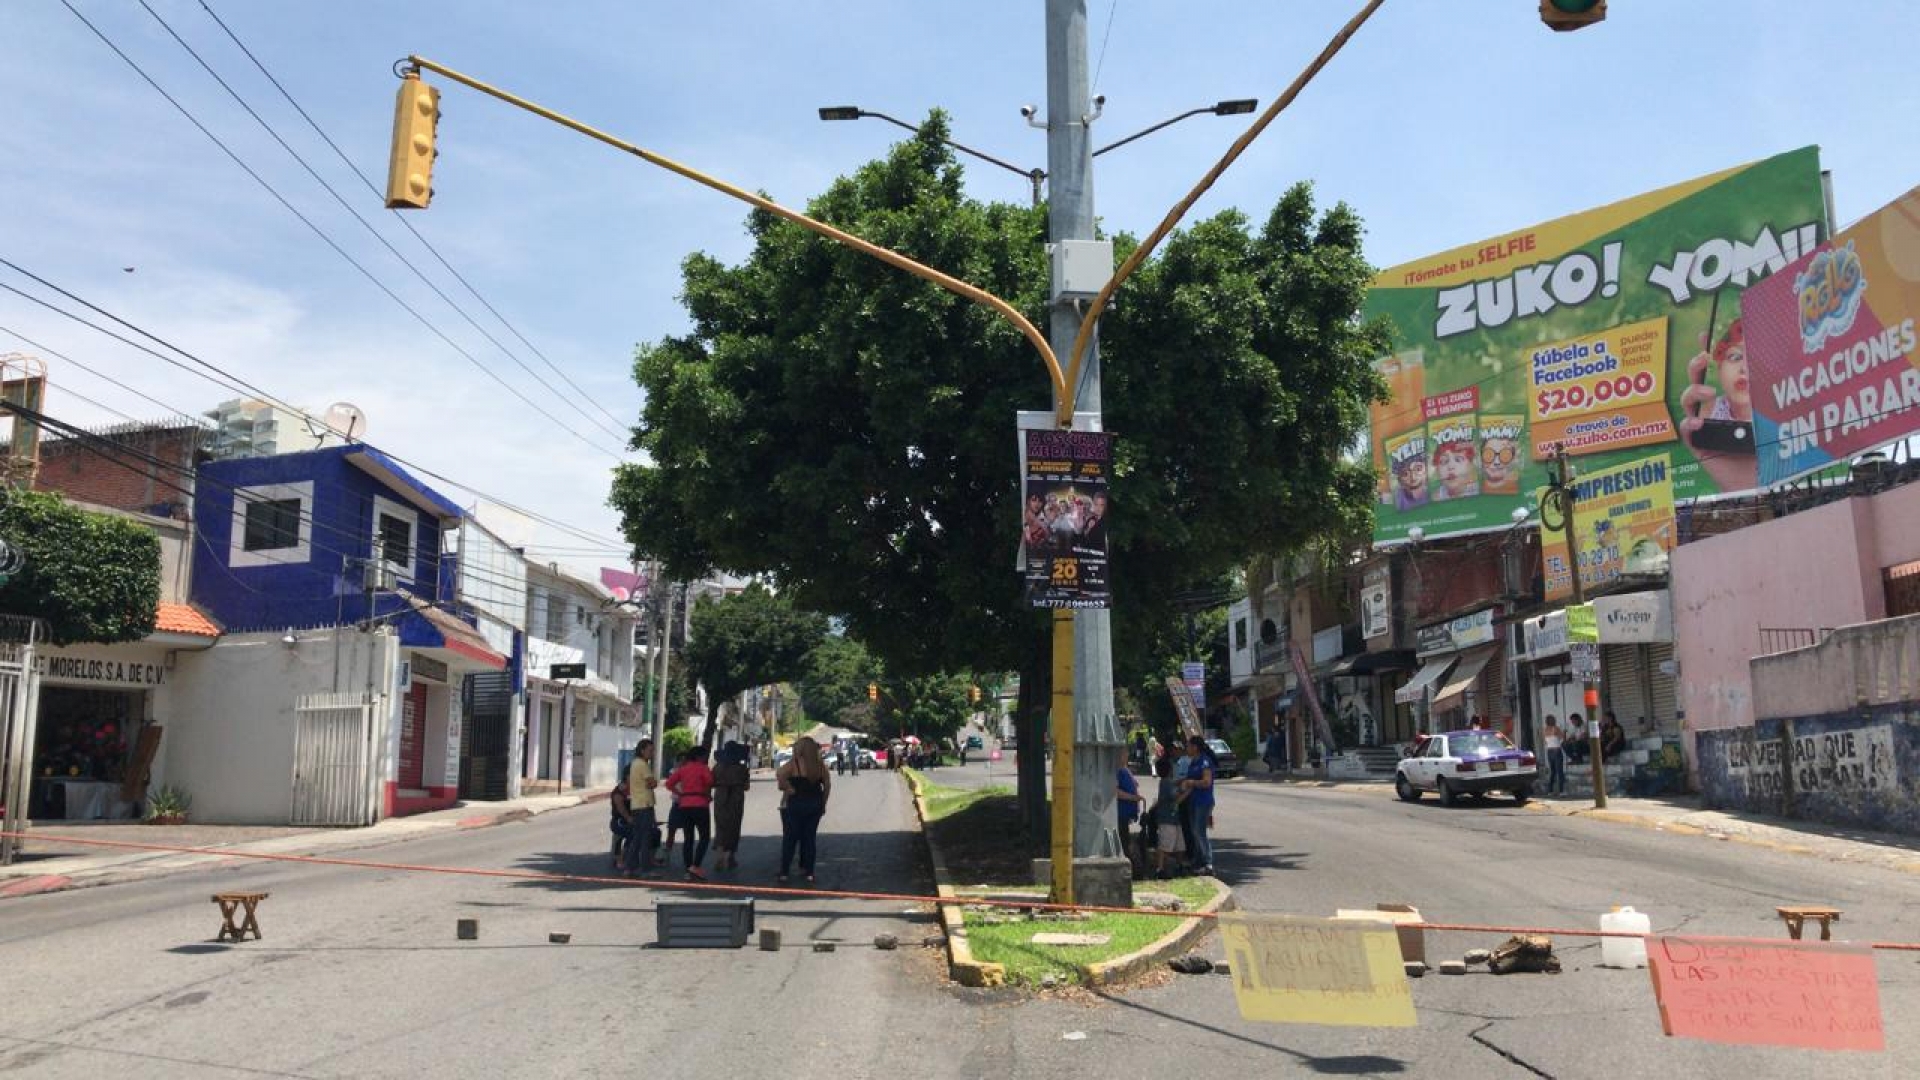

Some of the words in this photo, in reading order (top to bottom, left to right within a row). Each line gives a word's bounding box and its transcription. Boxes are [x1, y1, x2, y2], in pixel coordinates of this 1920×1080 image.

[1460, 257, 1474, 271] tu
[1478, 233, 1537, 265] SELFIE
[1436, 240, 1623, 338] ZUKO!
[1620, 331, 1658, 347] puedes
[1533, 343, 1589, 368] Súbela
[1594, 341, 1606, 355] a
[1772, 318, 1916, 410] VACACIONES
[1534, 355, 1617, 386] Facebook
[1537, 371, 1654, 415] $20,000
[1778, 409, 1819, 460] SIN
[1823, 367, 1920, 443] PARAR
[1566, 425, 1573, 434] a
[1053, 563, 1078, 580] 20
[129, 663, 142, 683] DE
[1824, 732, 1857, 759] QUE
[1671, 965, 1719, 982] LAS
[1728, 965, 1873, 989] MOLESTIAS
